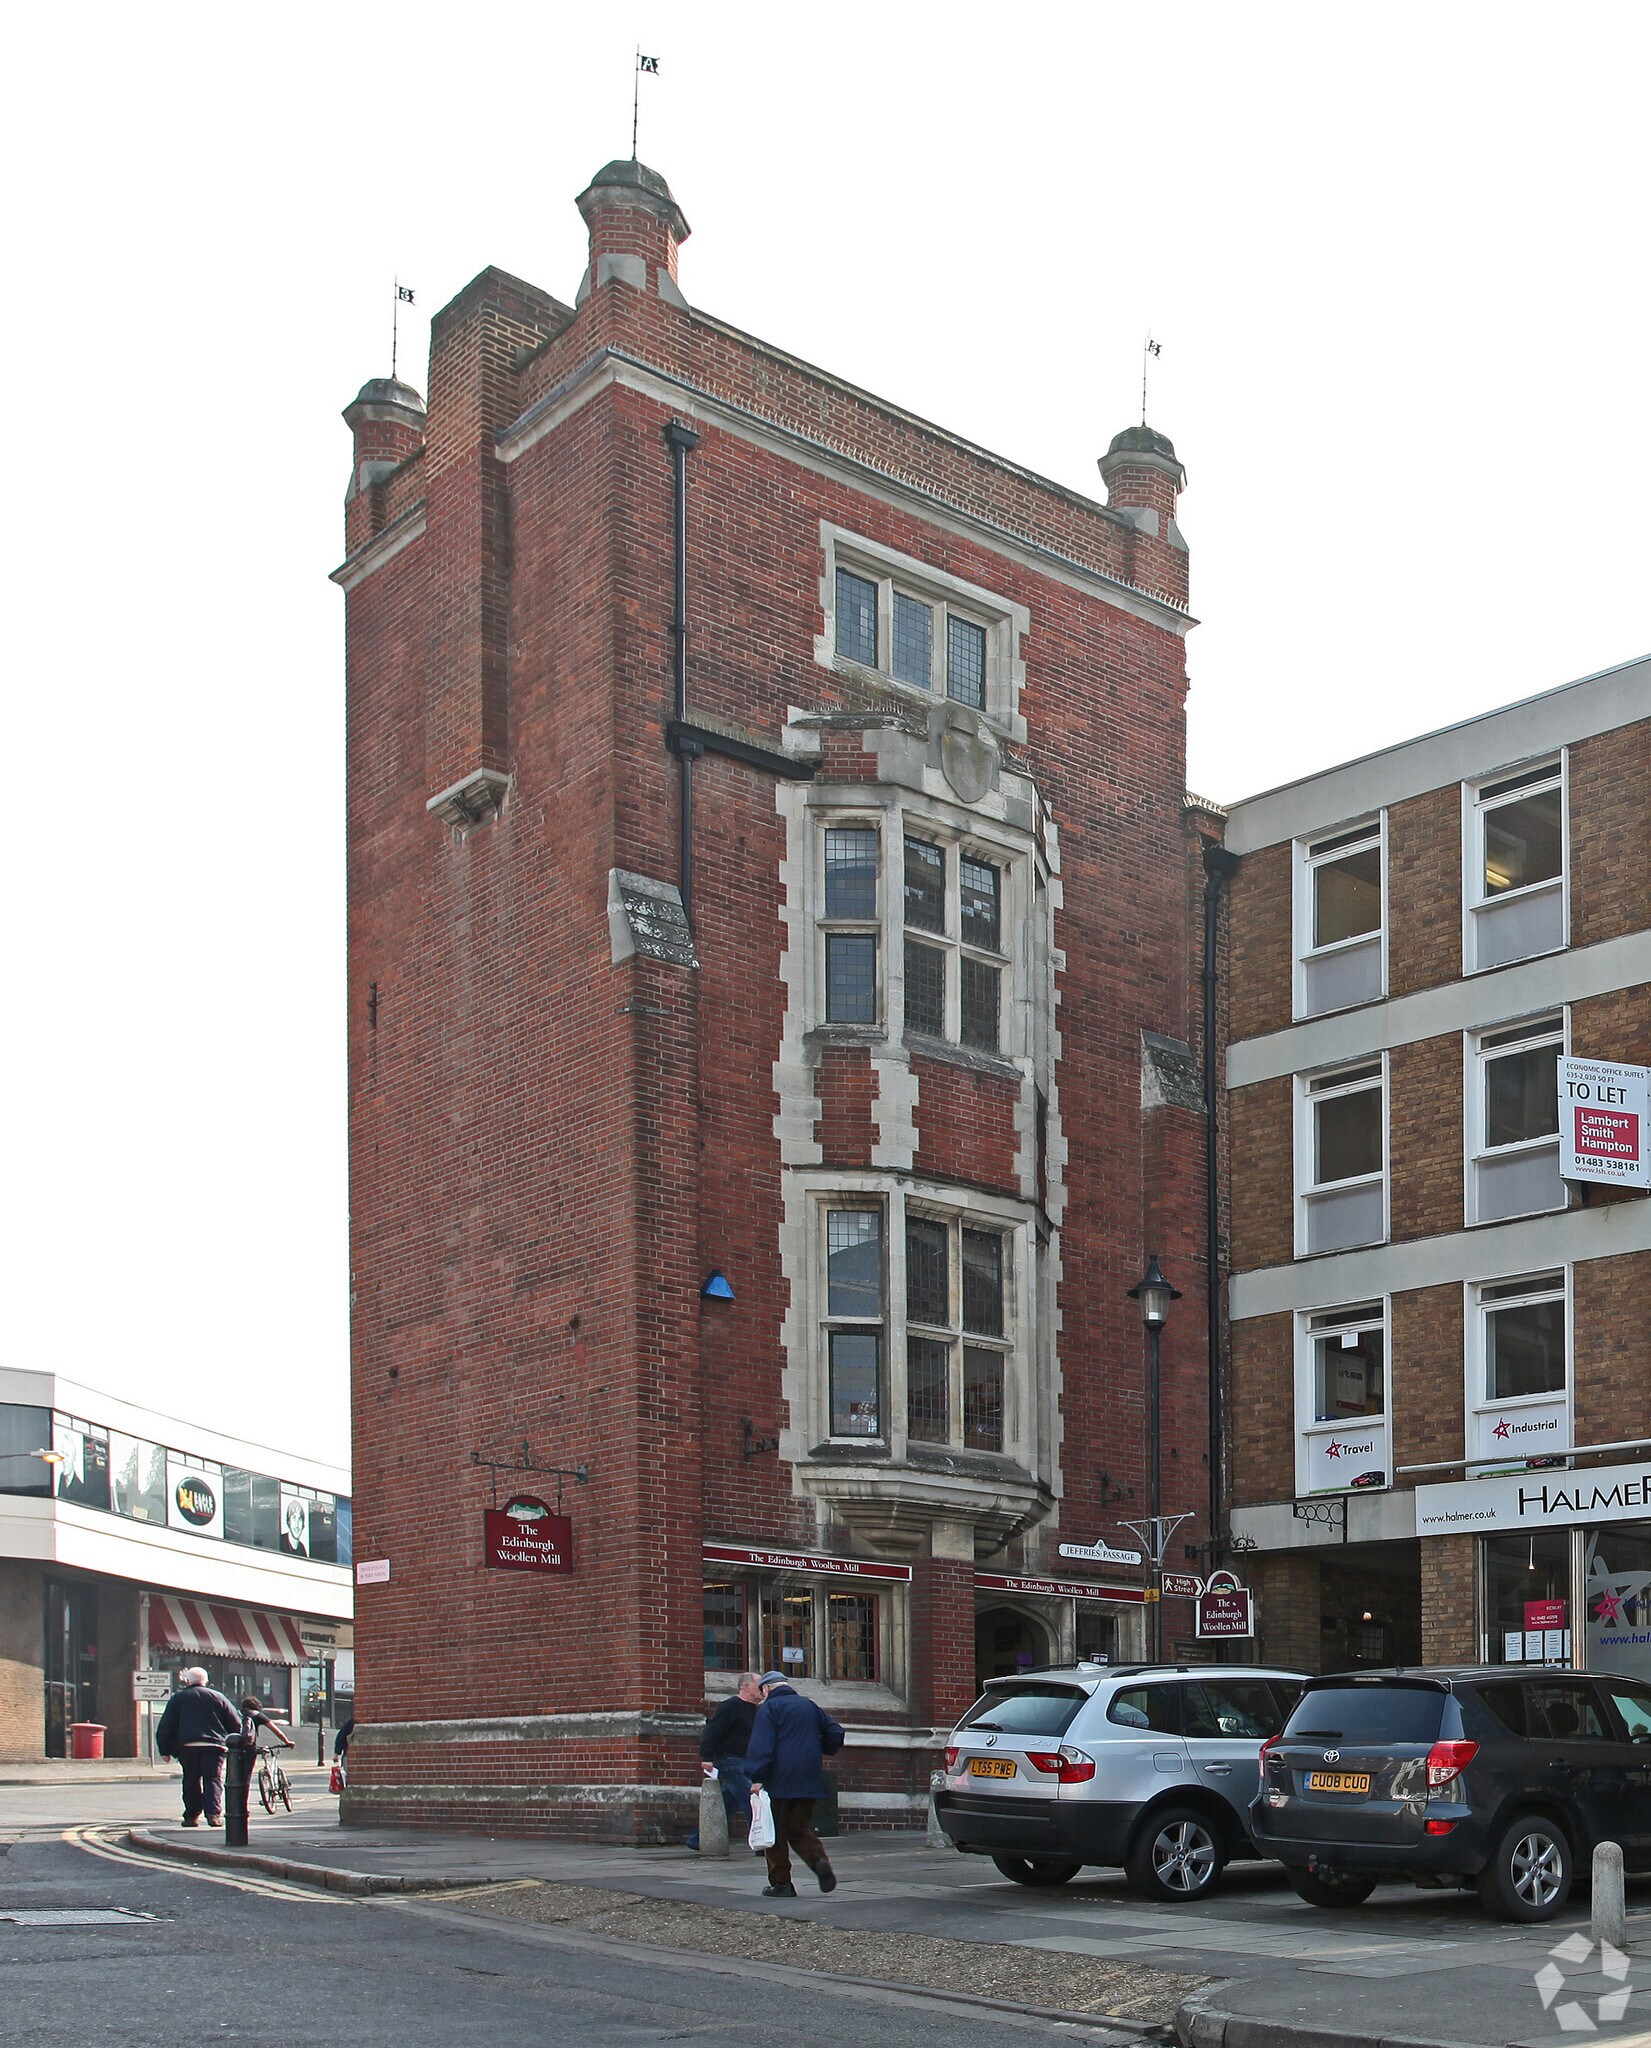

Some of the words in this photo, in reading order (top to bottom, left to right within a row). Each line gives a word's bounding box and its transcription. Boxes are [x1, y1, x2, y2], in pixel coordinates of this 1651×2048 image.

[1566, 1063, 1600, 1073] ECONOMIC
[1602, 1067, 1622, 1076] OFFICE
[1624, 1070, 1644, 1079] SUITES
[1566, 1081, 1591, 1100] TO
[1597, 1085, 1627, 1104] LET
[1581, 1112, 1629, 1129] Lambert
[1581, 1125, 1614, 1139] Smith
[1581, 1136, 1633, 1153] Hampton
[1575, 1156, 1603, 1167] 01483
[1606, 1160, 1640, 1172] 538181
[1575, 1166, 1626, 1177] www.lsh.co.uk
[1511, 1419, 1558, 1434] Industrial
[1342, 1441, 1373, 1455] Travel
[1422, 1507, 1497, 1524] www.halmer.co.uk
[518, 1524, 538, 1535] The
[502, 1536, 554, 1552] Edinburgh
[497, 1550, 537, 1563] Woollen
[541, 1553, 561, 1565] Mill
[1066, 1546, 1100, 1558] JEFFRIES
[1103, 1550, 1135, 1561] PASSAGE
[749, 1553, 764, 1562] The
[768, 1555, 807, 1568] Edinburgh
[811, 1559, 840, 1570] Woollen
[844, 1563, 860, 1572] Mill
[1005, 1579, 1018, 1588] The
[1021, 1581, 1055, 1593] Edinburgh
[1058, 1585, 1083, 1594] Woollen
[1086, 1588, 1099, 1596] Mill
[1173, 1584, 1194, 1593] Street
[1176, 1578, 1191, 1586] High
[1217, 1599, 1230, 1607] The
[1206, 1610, 1242, 1620] Edinburgh
[1202, 1622, 1231, 1631] Woollen
[1232, 1621, 1246, 1630] Mill
[1600, 1632, 1651, 1644] www.hal
[971, 1760, 992, 1773] LT55
[994, 1762, 1012, 1776] PWE
[1311, 1774, 1341, 1788] CU08
